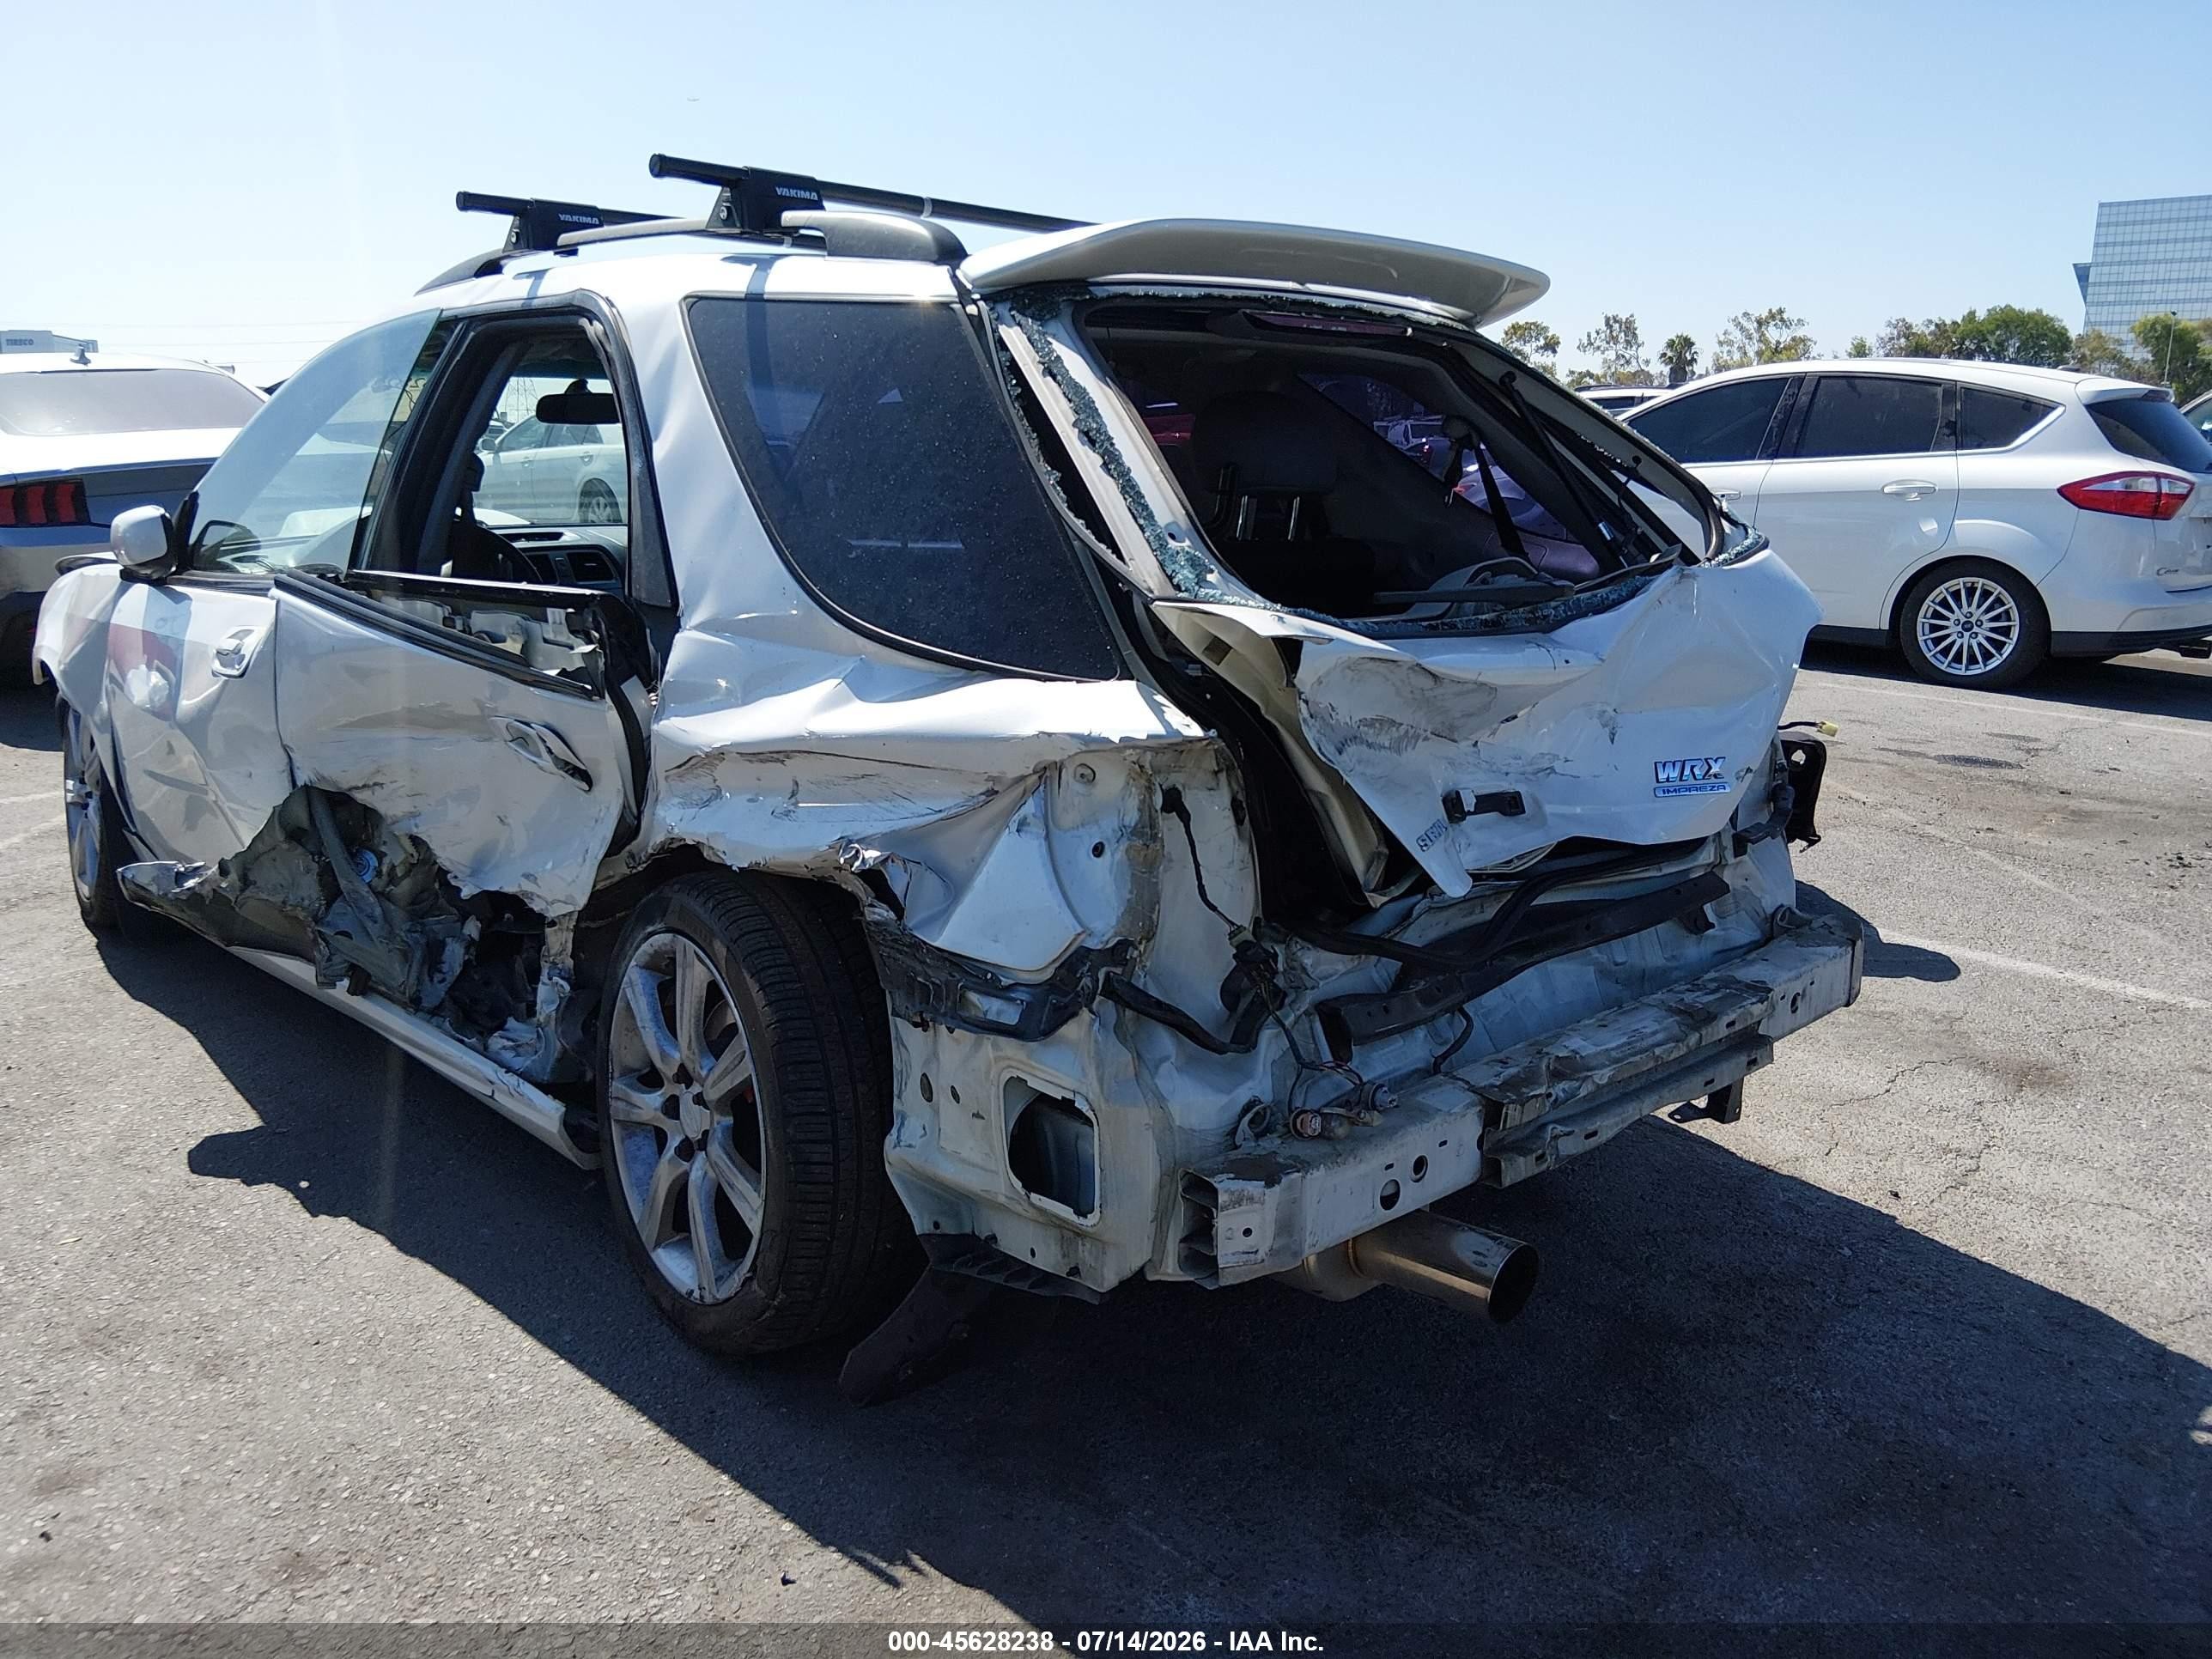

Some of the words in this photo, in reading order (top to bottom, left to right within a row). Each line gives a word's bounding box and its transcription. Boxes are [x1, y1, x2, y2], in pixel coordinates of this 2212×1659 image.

[775, 186, 818, 200] YAKIMA
[557, 213, 599, 225] YAKIMA
[1654, 757, 1726, 783] WRX
[1662, 783, 1727, 795] IMPREZA
